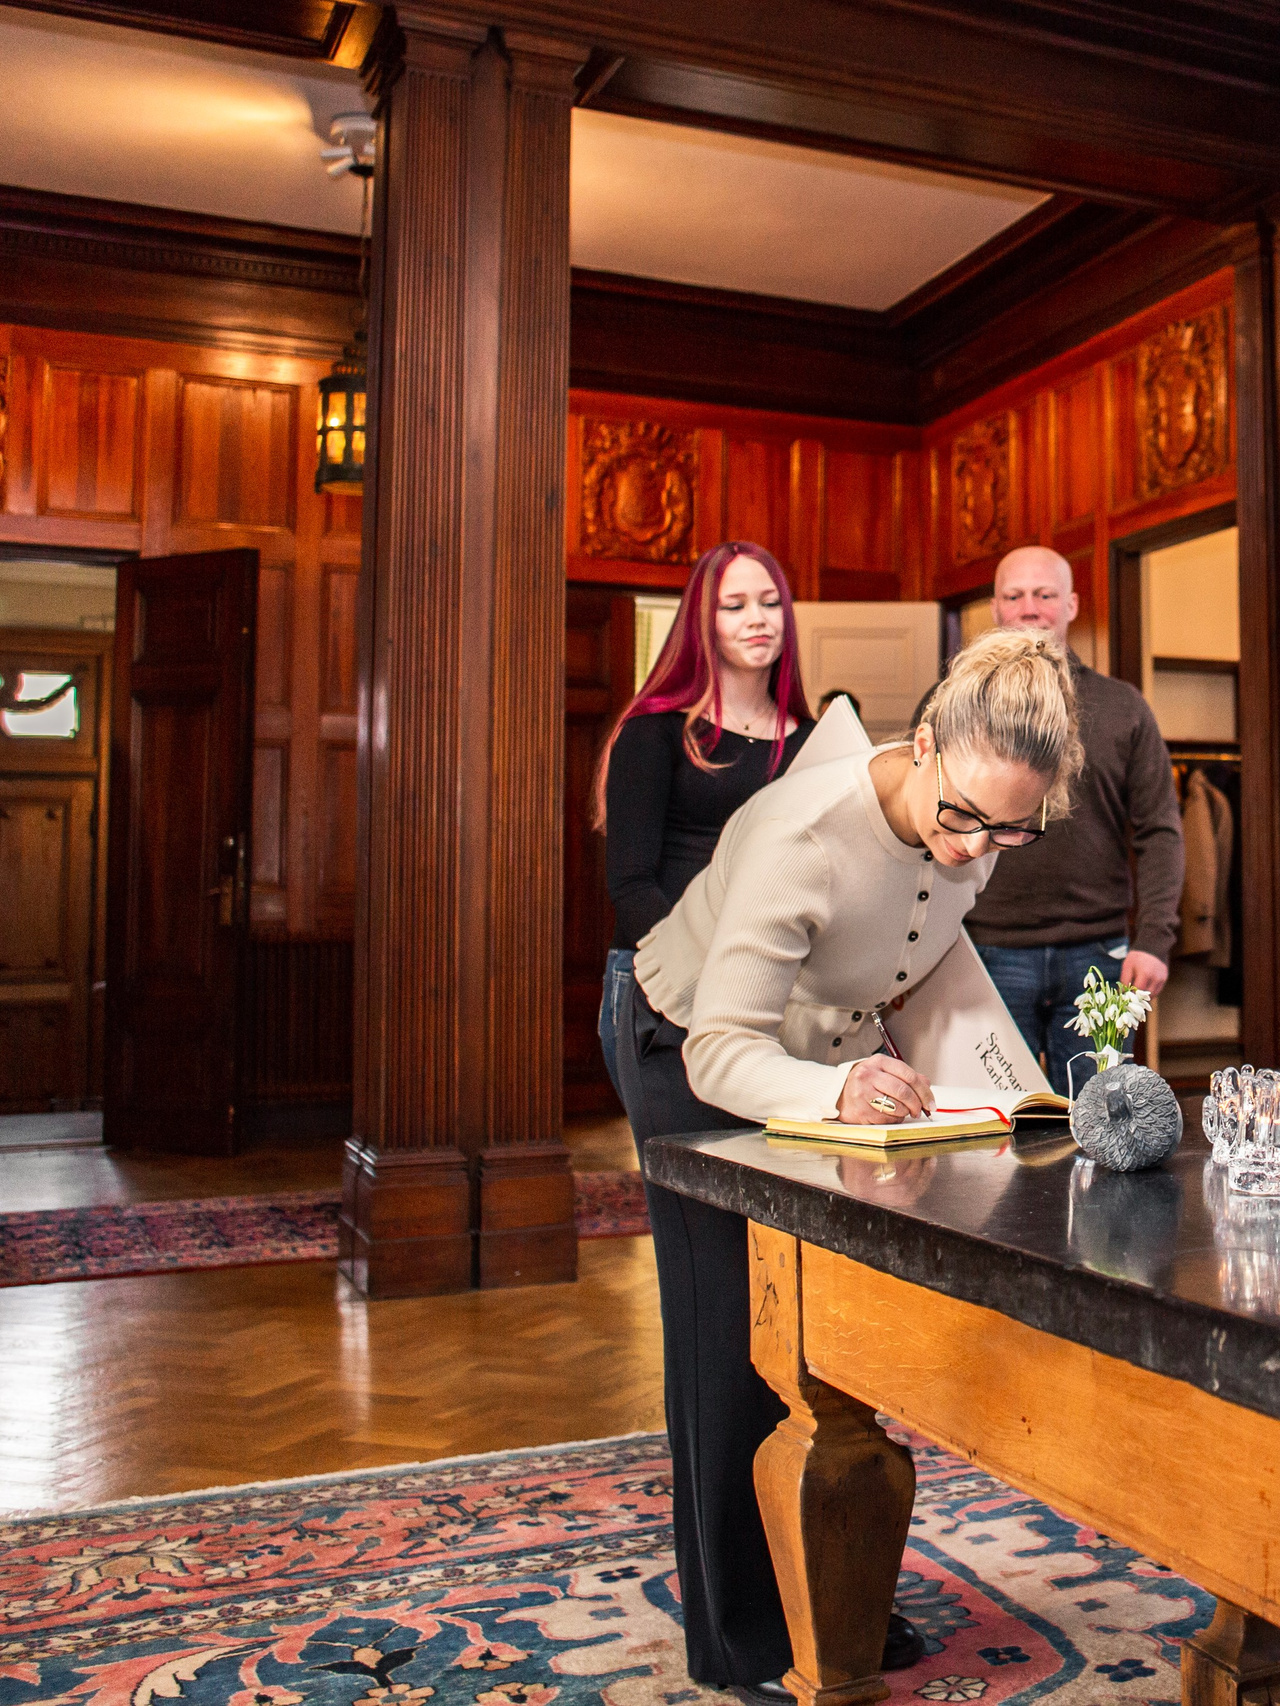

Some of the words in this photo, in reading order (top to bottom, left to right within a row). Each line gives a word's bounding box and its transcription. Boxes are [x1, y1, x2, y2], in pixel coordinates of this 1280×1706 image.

[975, 1041, 983, 1051] i
[980, 1049, 1009, 1091] Karls
[986, 1032, 1027, 1092] Sparban
